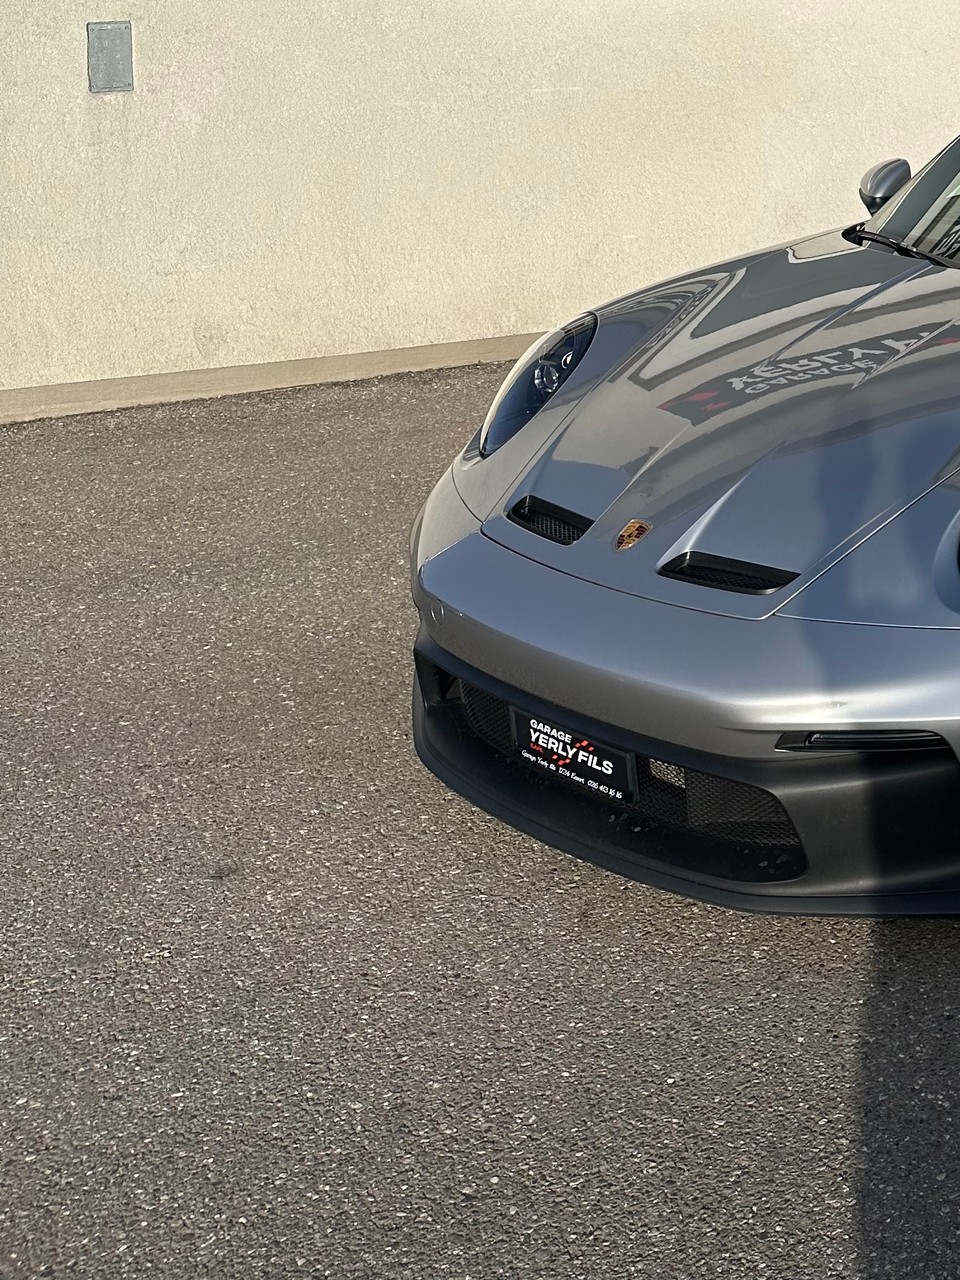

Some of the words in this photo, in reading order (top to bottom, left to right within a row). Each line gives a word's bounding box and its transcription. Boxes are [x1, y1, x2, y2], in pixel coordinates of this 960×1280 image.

[529, 719, 573, 744] GARAGE
[529, 728, 578, 759] YERLY
[577, 749, 614, 775] FILS
